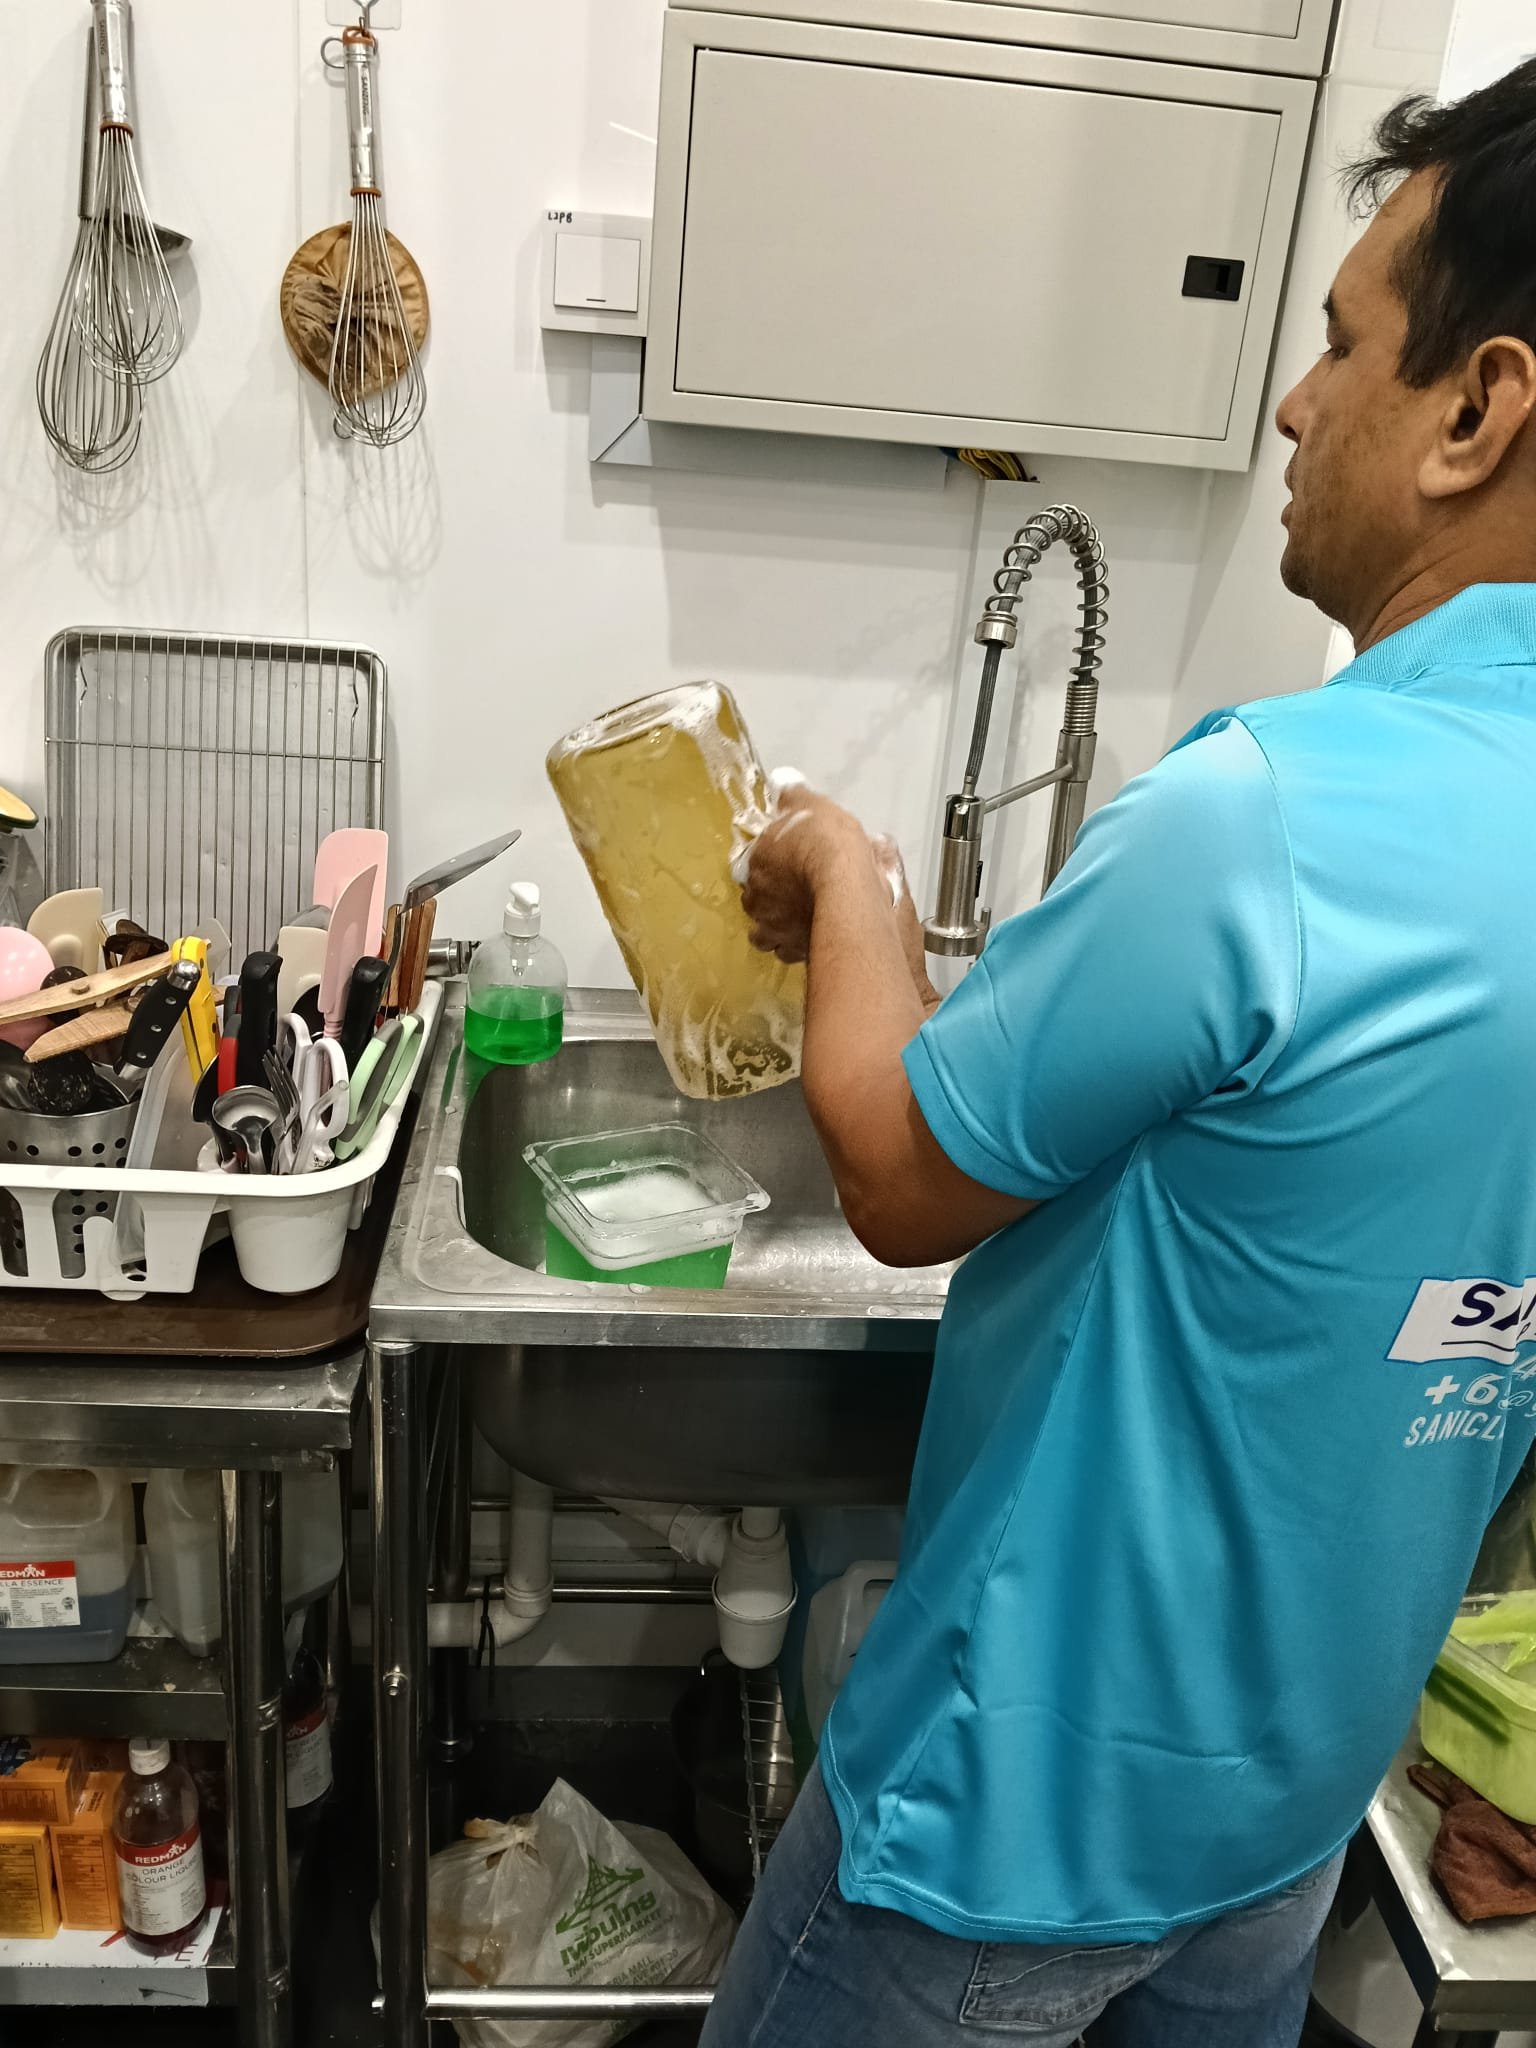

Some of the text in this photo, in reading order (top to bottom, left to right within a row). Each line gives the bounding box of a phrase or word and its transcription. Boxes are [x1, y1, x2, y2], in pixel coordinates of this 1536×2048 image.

[1404, 1409, 1504, 1447] SANICL
[135, 1843, 187, 1864] REDMAN
[142, 1859, 184, 1876] ORANGE
[566, 1956, 589, 1978] THAI
[590, 1909, 661, 1960] SUPERMARKET
